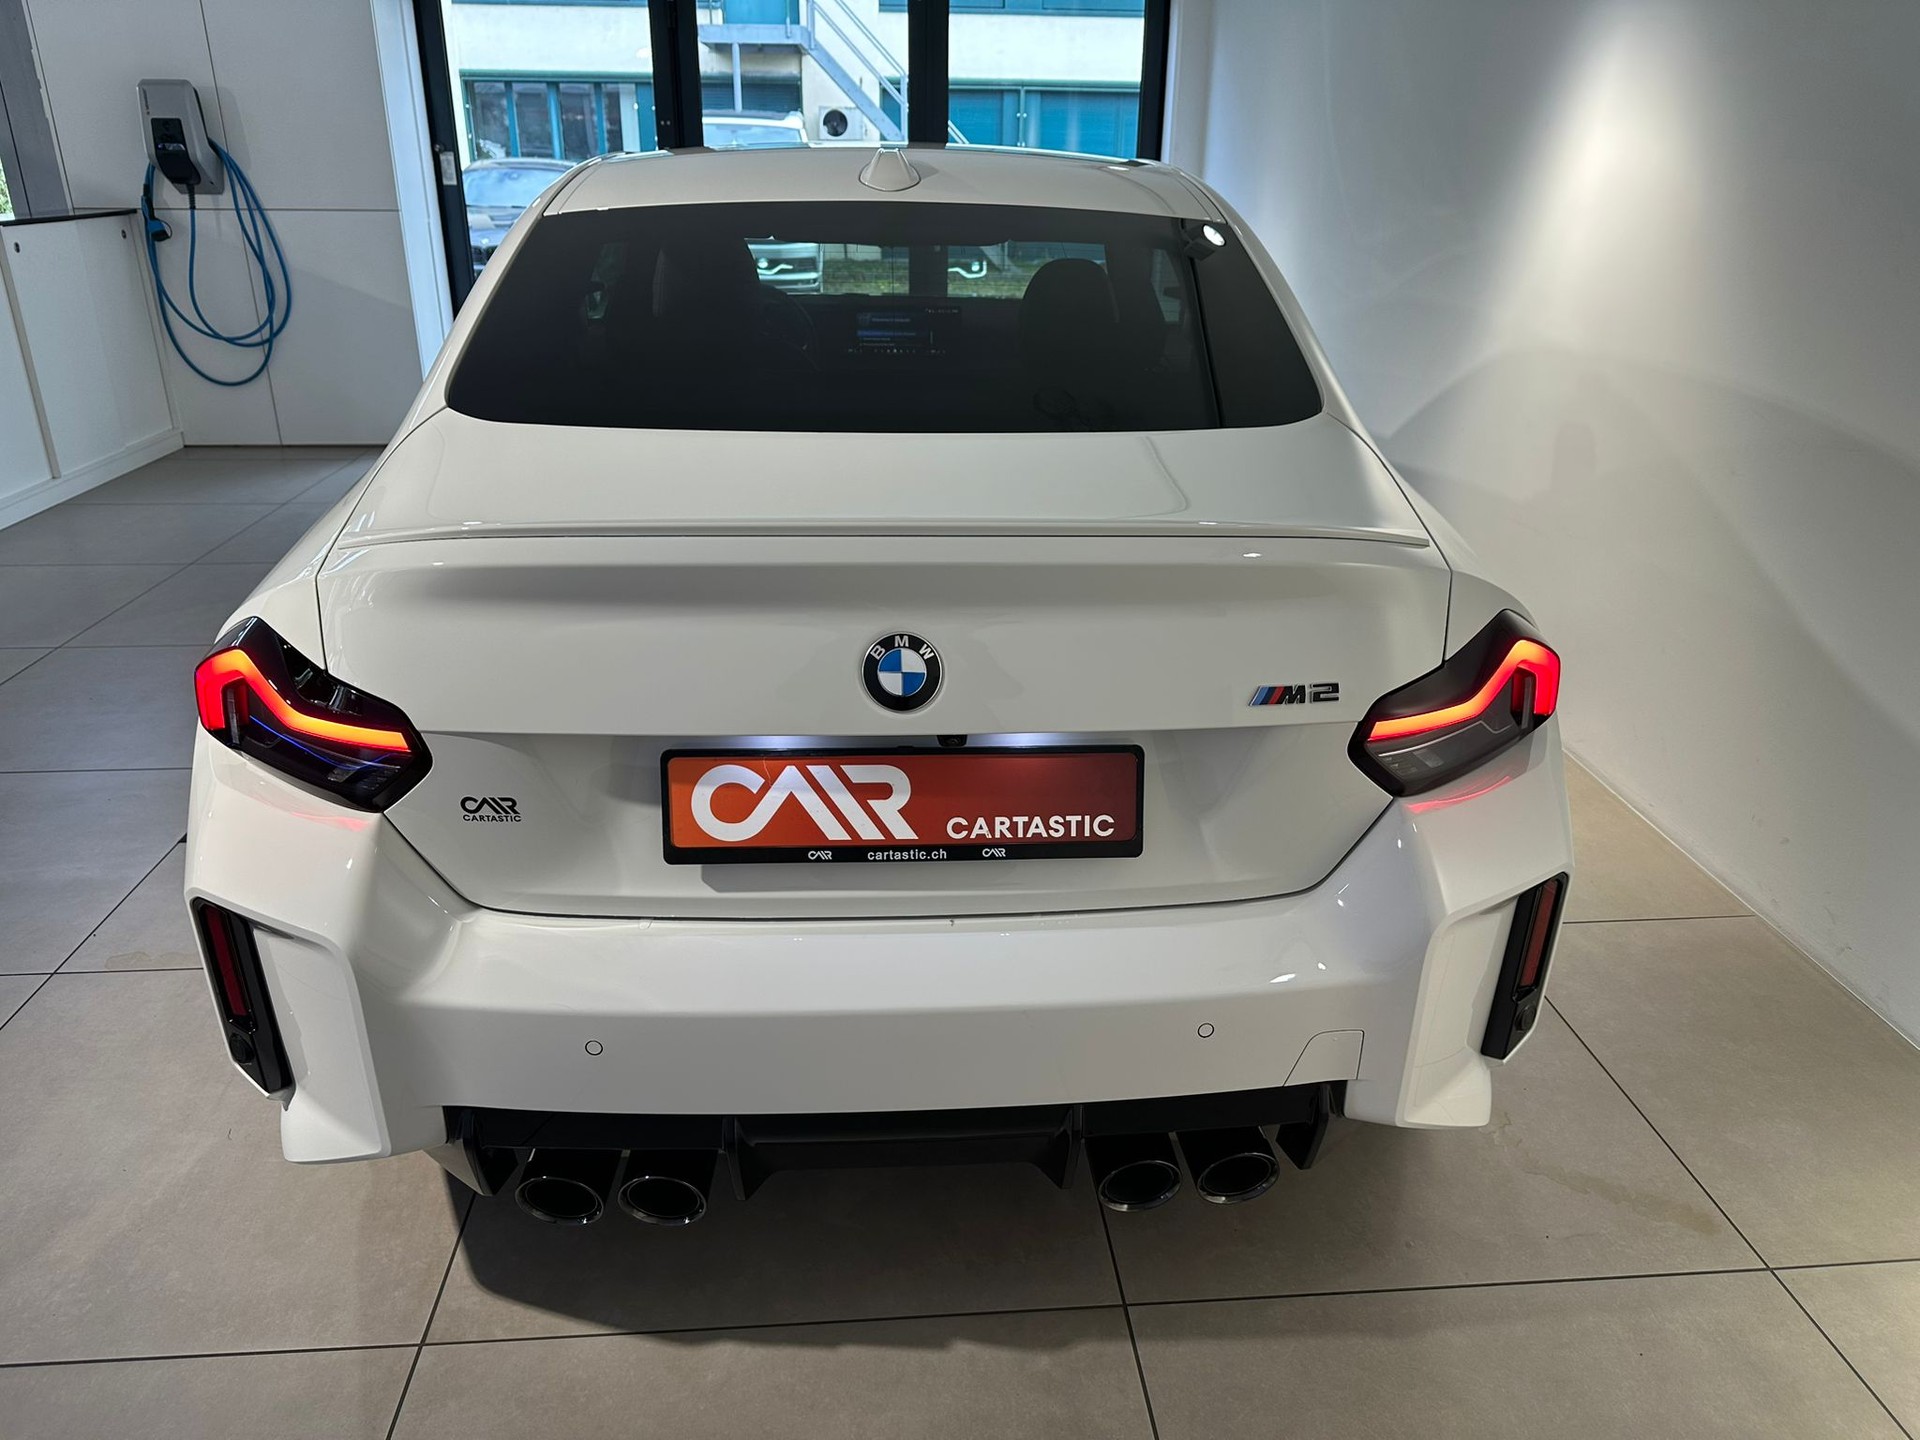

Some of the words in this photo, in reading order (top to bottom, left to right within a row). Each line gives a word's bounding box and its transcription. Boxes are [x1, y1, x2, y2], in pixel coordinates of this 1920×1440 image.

[870, 635, 934, 660] BMW
[462, 814, 522, 823] CARTASTIC
[946, 814, 1115, 839] CARTASTIC
[867, 849, 947, 861] cartastic.ch
